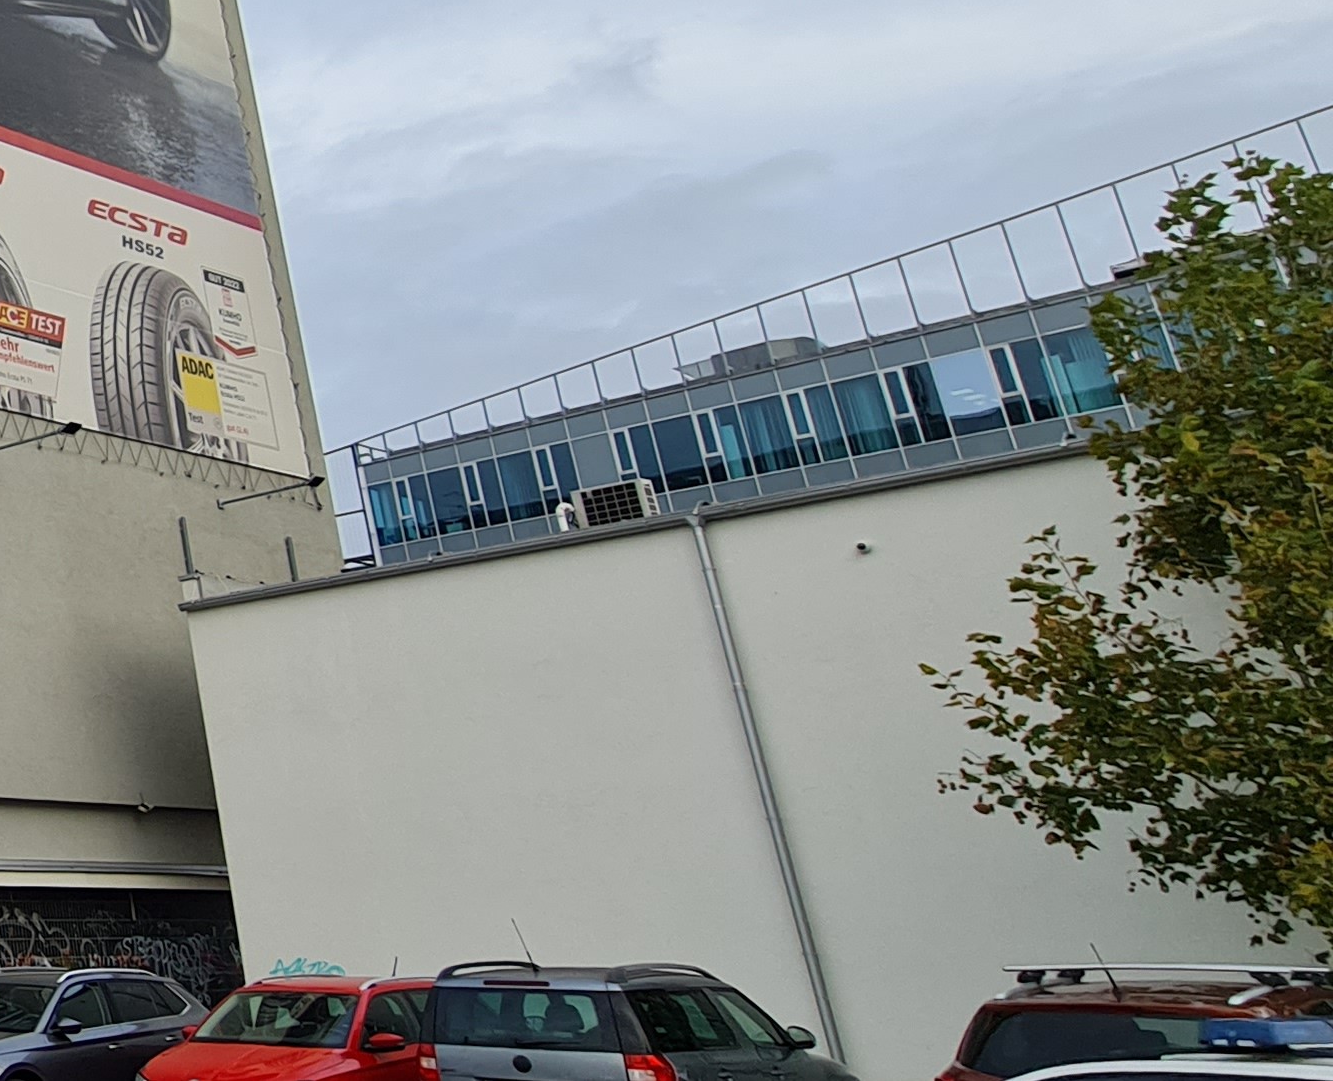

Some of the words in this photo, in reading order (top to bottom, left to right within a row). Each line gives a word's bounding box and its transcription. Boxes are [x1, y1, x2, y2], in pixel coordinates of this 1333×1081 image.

[121, 235, 165, 260] HS52
[30, 313, 63, 336] TEST
[181, 356, 214, 380] ADAC
[188, 412, 204, 425] Test
